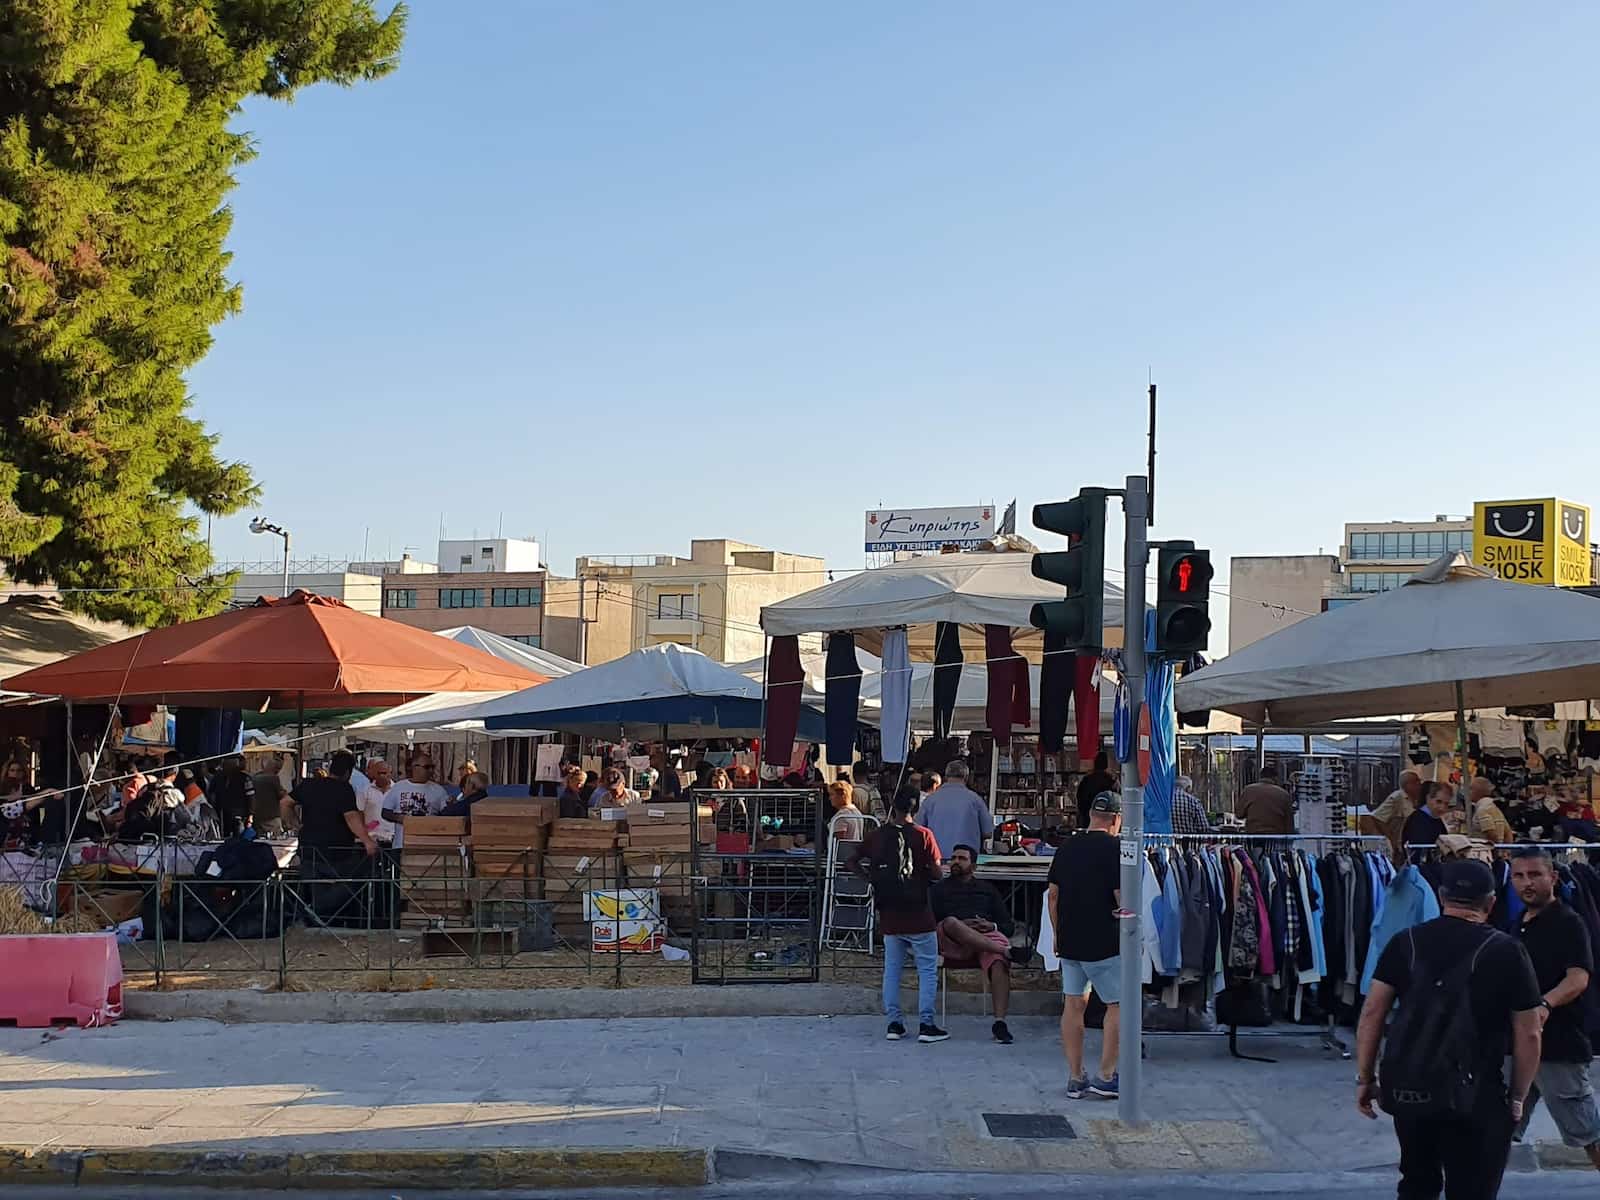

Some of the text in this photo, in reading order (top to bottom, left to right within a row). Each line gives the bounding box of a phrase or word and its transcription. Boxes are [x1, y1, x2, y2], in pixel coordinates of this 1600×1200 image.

[879, 512, 981, 539] Κυπριώτης
[871, 542, 893, 552] ΕΙΔΗ
[1483, 544, 1545, 562] SMILE
[1560, 545, 1585, 565] SMILE
[1483, 561, 1544, 579] IOSK
[1560, 562, 1585, 582] KIOSK
